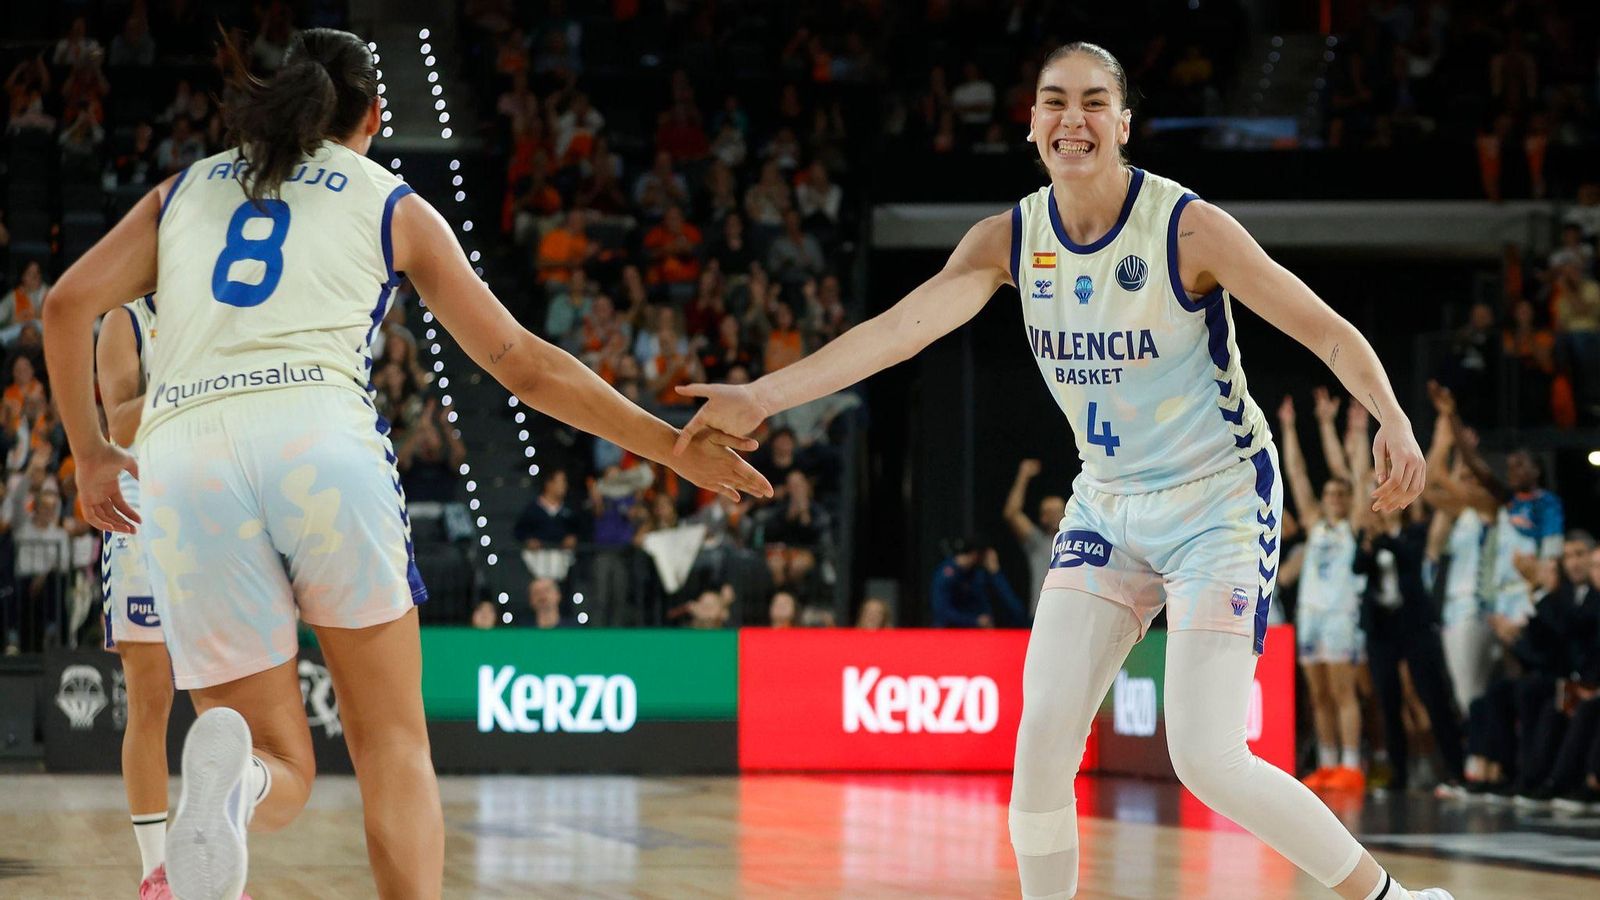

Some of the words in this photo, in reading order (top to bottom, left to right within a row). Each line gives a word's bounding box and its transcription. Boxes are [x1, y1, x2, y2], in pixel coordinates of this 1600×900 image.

[211, 198, 291, 308] 8
[1028, 324, 1160, 361] VALENCIA
[1055, 367, 1123, 385] BASKET
[1087, 401, 1120, 457] 4
[130, 602, 155, 615] PUL
